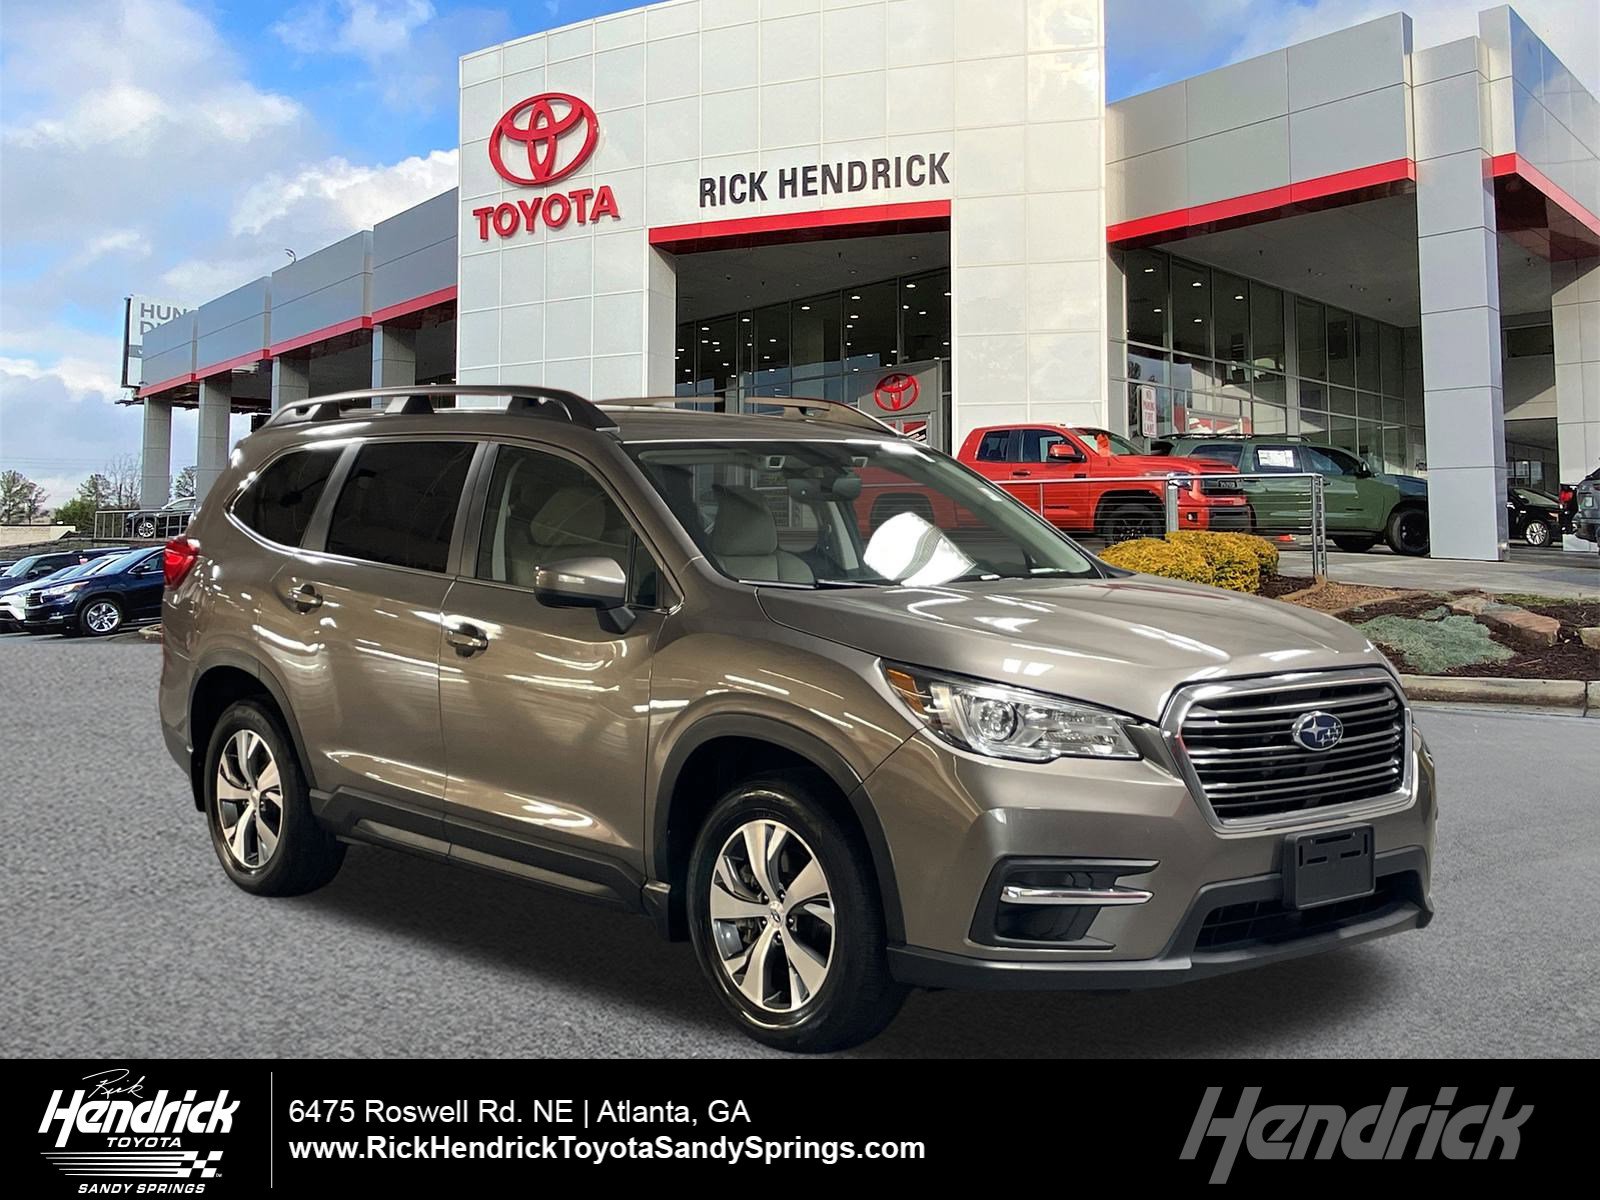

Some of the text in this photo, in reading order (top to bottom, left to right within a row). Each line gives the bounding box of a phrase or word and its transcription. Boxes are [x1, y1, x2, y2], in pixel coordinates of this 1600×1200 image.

[699, 151, 951, 208] RICK HENDRICK
[472, 185, 621, 241] TOYOTA
